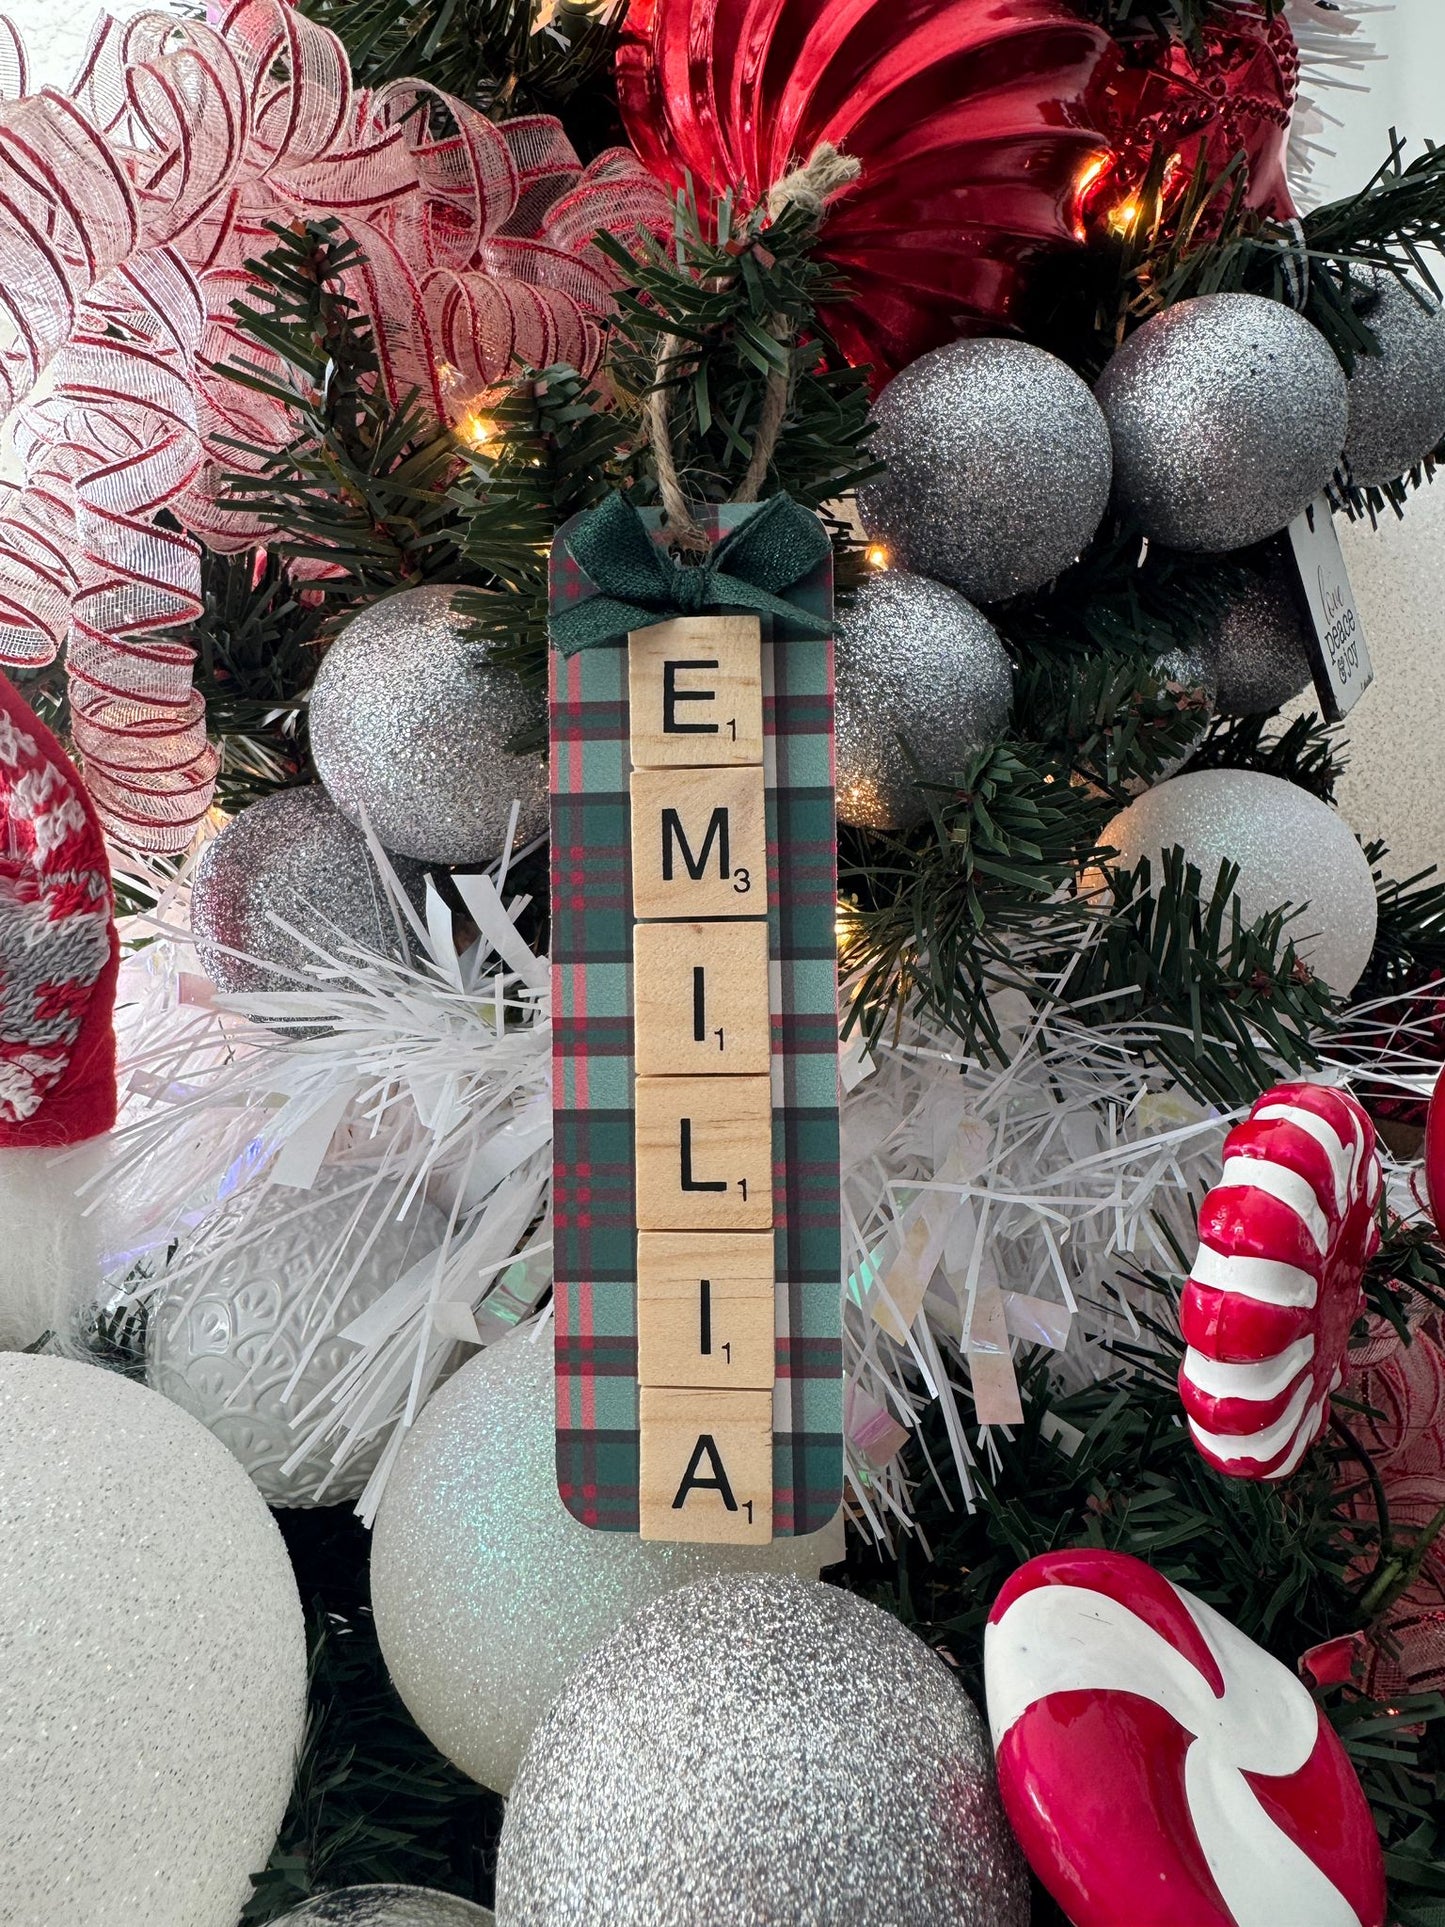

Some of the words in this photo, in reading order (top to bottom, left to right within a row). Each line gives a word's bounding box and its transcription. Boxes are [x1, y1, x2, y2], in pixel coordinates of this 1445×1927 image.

[1324, 609, 1356, 666] peace
[726, 718, 736, 742] 1
[733, 868, 751, 893] 3
[714, 1027, 724, 1051] 1
[737, 1178, 747, 1202] 1
[721, 1342, 731, 1365] 1
[741, 1499, 753, 1525] 1
